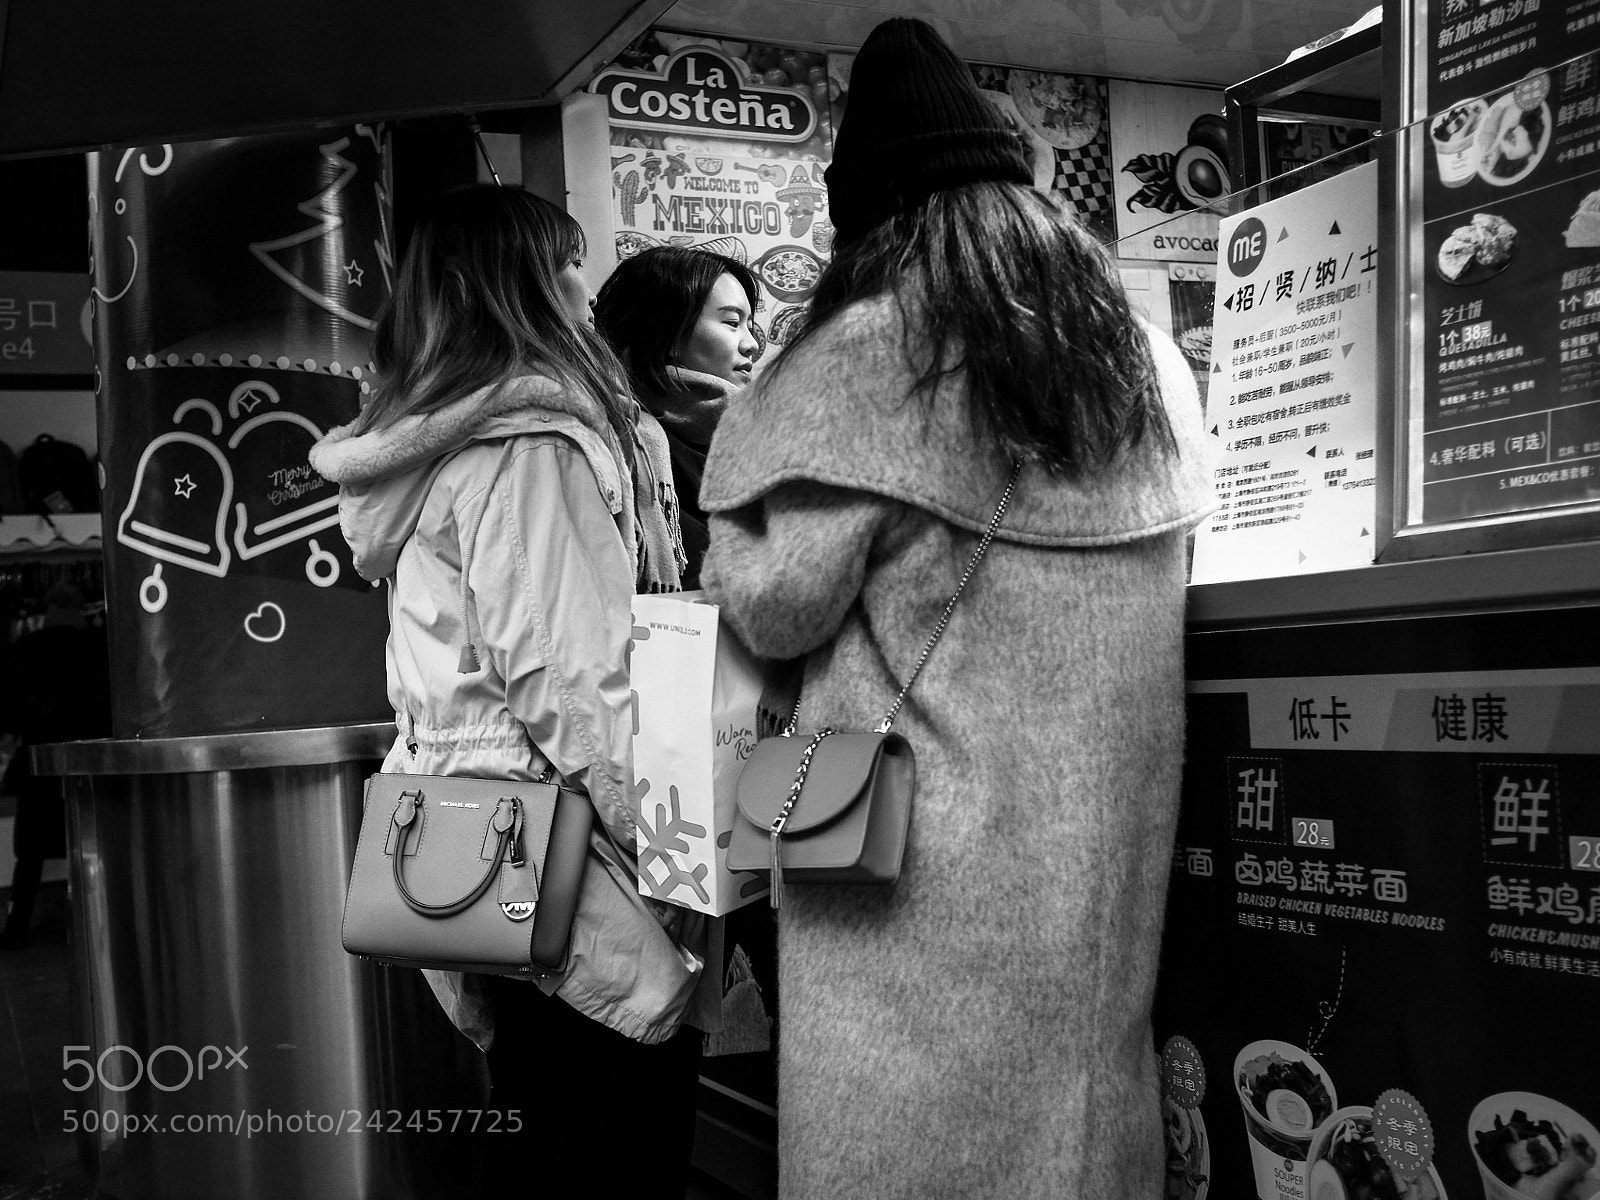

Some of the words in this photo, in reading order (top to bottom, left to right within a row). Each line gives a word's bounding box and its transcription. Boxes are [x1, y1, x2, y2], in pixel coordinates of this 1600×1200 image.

[686, 57, 728, 89] La
[610, 82, 795, 130] Costeña
[683, 176, 741, 195] WELCOME
[744, 180, 759, 194] TO
[652, 194, 782, 236] MEXICO
[1438, 332, 1508, 357] QUESADILLA
[267, 464, 312, 486] Merry
[1289, 696, 1352, 742] 低卡
[1432, 693, 1509, 743] 健康
[716, 723, 753, 747] Warm
[440, 801, 464, 809] MICHAEL
[464, 802, 480, 810] KORS
[1236, 767, 1279, 832] 甜
[1491, 775, 1551, 852] 鲜
[1235, 851, 1408, 903] 卤鸡蔬菜面
[1236, 891, 1277, 908] BRAISED
[1278, 897, 1322, 915] CHICKEN
[1323, 903, 1390, 924] VEGETABLES
[1391, 912, 1446, 932] NOODLES
[1238, 911, 1275, 930] 结婚生子
[1489, 947, 1542, 969] 小有成就
[1386, 1116, 1418, 1137] 冬季
[1387, 1134, 1420, 1157] 限定
[1274, 1167, 1305, 1187] SOUPER
[1275, 1179, 1305, 1199] Noodles
